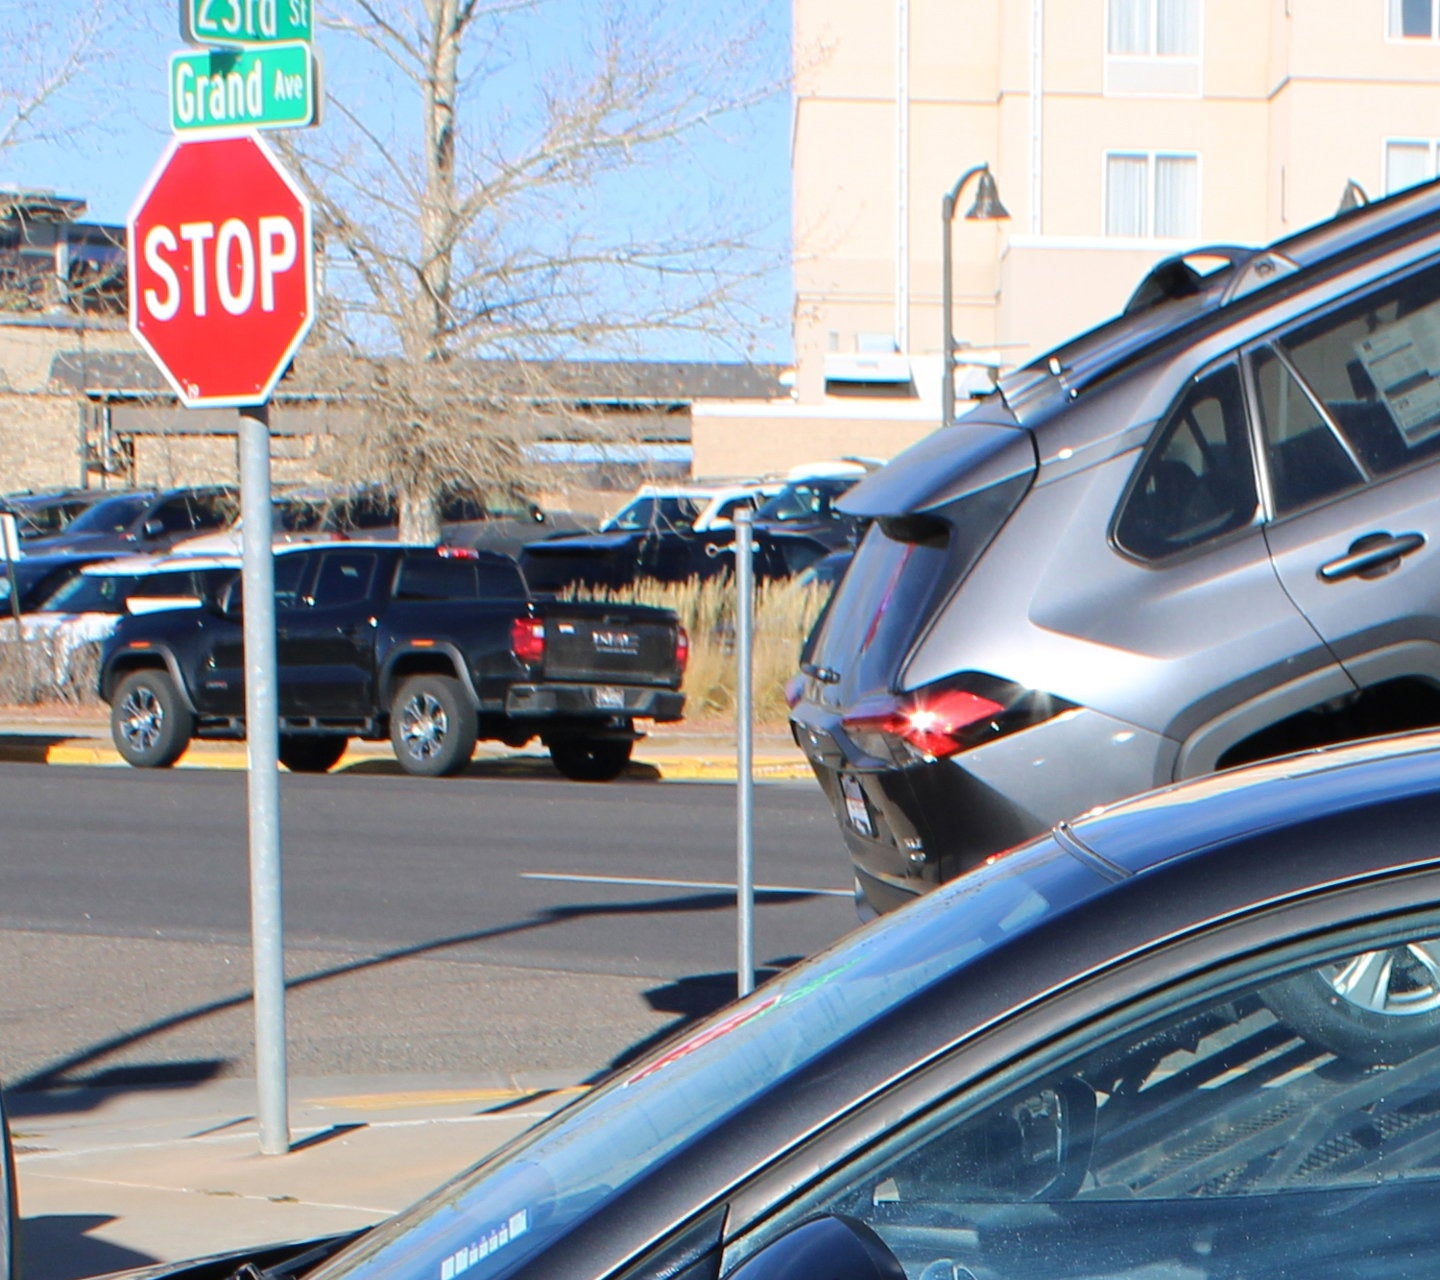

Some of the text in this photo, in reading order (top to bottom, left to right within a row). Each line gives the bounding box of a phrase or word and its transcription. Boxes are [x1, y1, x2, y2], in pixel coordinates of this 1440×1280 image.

[289, 0, 308, 28] St
[175, 60, 304, 122] Grand Ave
[144, 216, 297, 322] STOP
